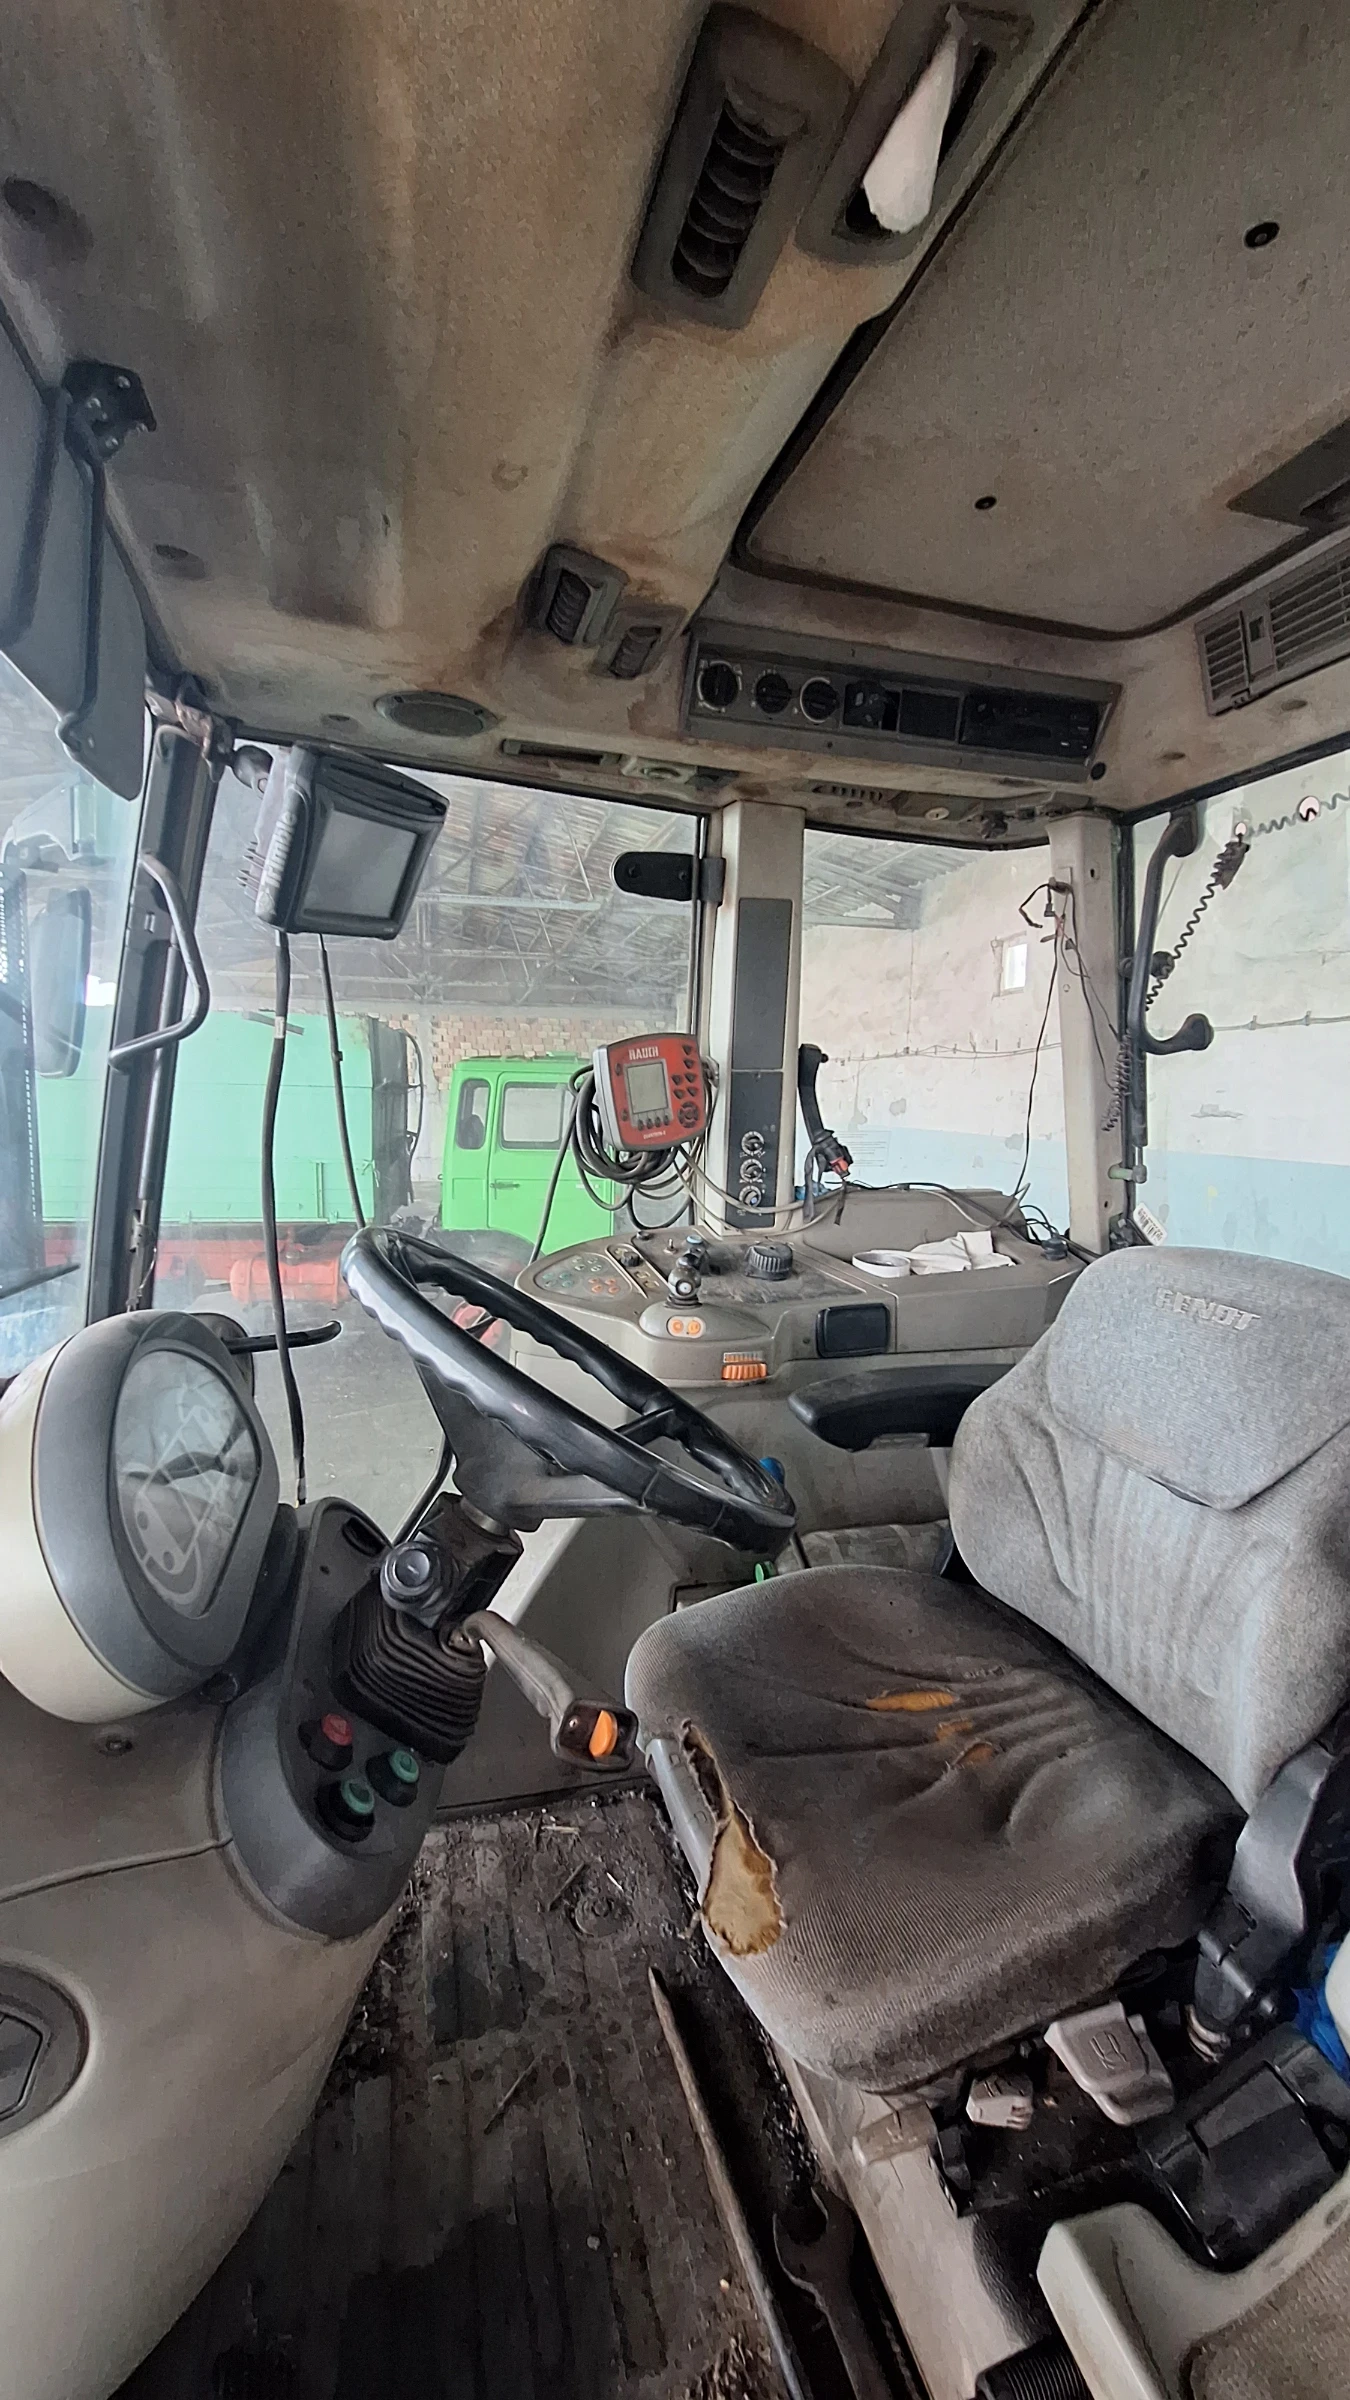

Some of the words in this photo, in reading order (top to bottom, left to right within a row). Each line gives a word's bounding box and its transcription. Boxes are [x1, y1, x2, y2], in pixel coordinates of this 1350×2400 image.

[261, 811, 298, 888] Trimble
[628, 1046, 659, 1060] RAUCH
[1155, 1287, 1261, 1331] FENDT
